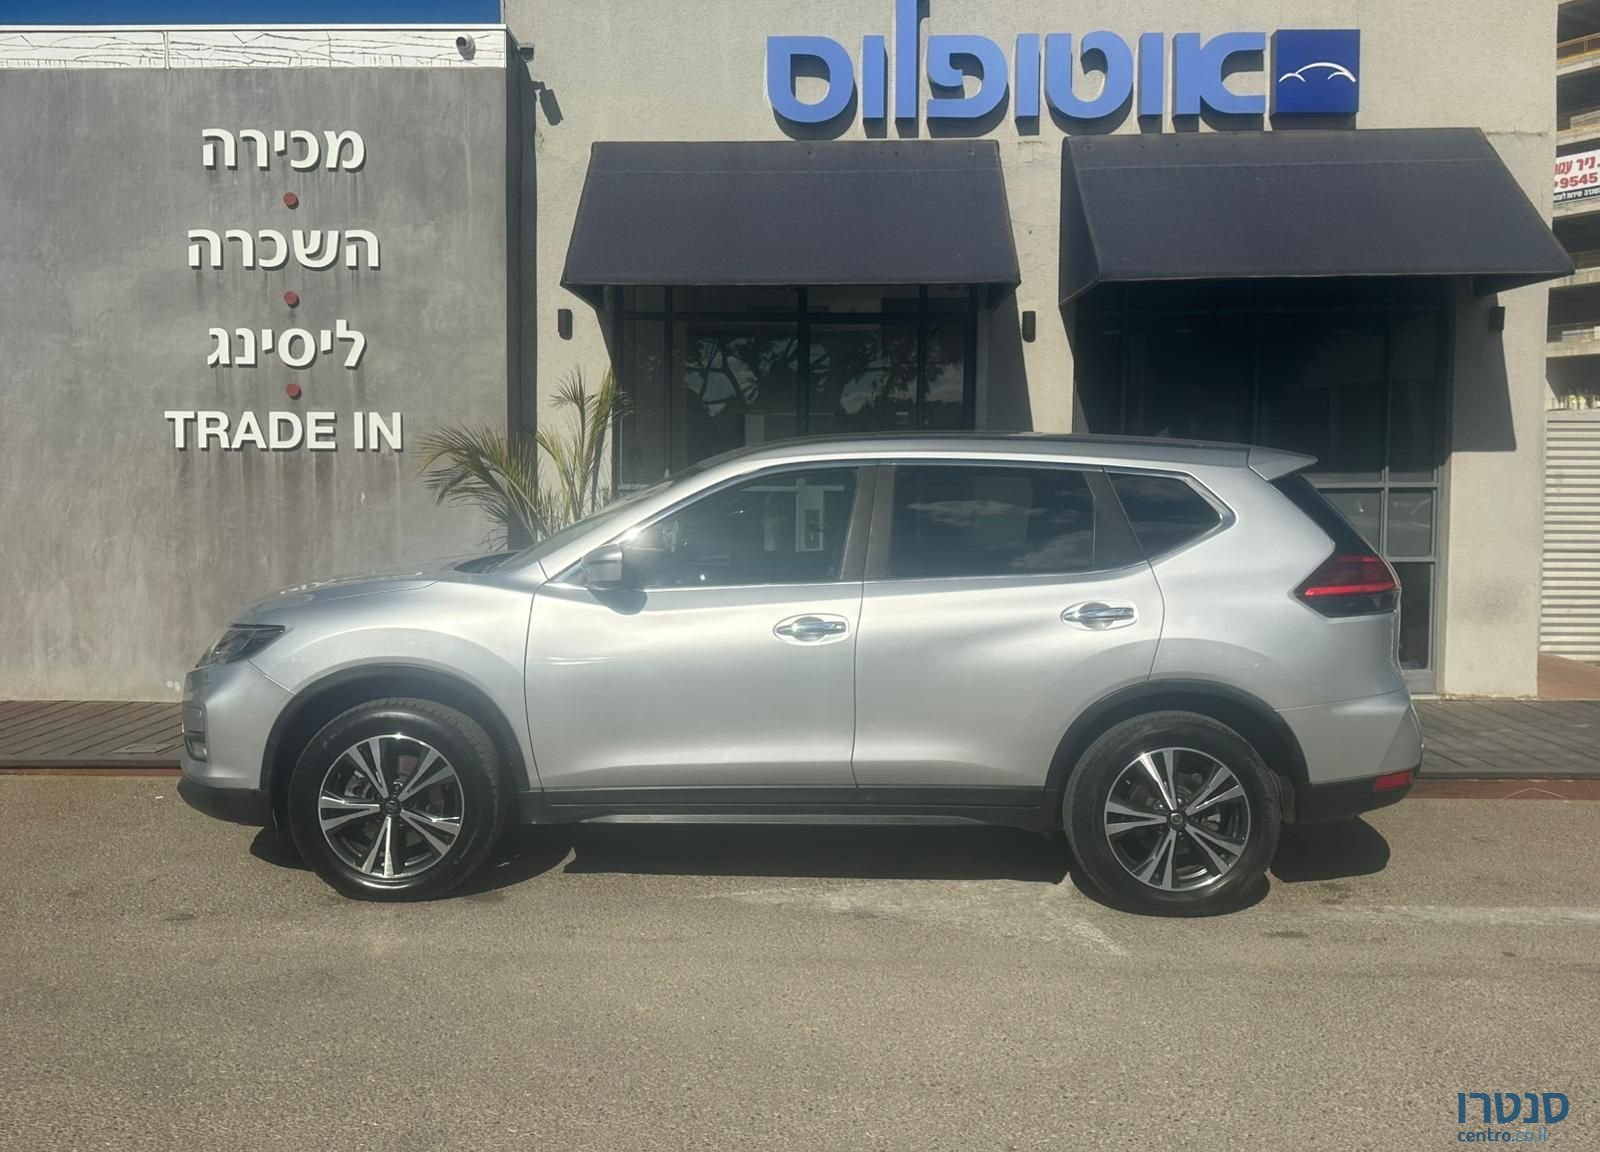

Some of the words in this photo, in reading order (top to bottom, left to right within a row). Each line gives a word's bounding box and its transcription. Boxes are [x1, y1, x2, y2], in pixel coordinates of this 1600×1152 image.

[766, 0, 1266, 122] אוטופלוס
[202, 128, 366, 169] מכירה
[187, 229, 380, 268] השכרה
[207, 319, 366, 367] ליסינג
[164, 411, 336, 449] TRADE
[354, 411, 402, 449] IN
